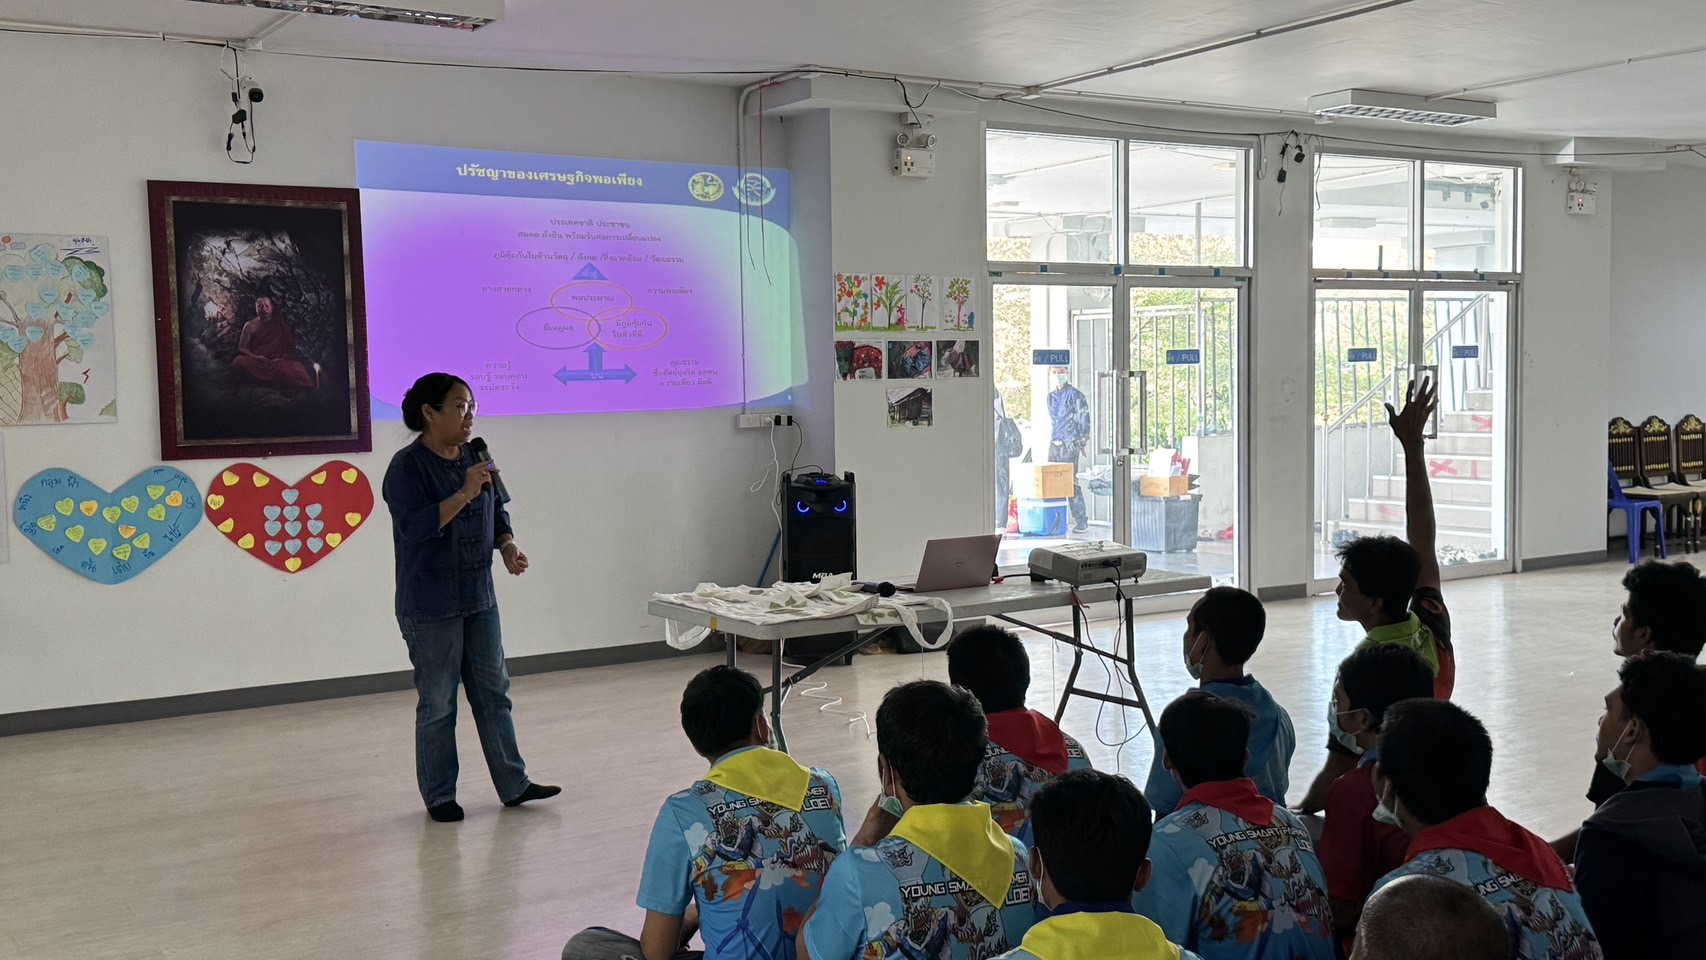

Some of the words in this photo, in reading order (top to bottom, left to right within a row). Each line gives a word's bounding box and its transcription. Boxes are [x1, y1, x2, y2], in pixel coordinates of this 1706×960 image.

[456, 163, 643, 186] ปรัชญาของเศรษฐกิจพอเพียง
[1050, 354, 1069, 363] PULL
[1181, 353, 1198, 362] PULL
[708, 800, 746, 815] YOUNG
[802, 798, 831, 811] LOEI
[1208, 831, 1247, 848] YOUNG
[1247, 827, 1280, 839] SMART
[900, 882, 945, 898] YOUNG
[1005, 886, 1031, 905] LOEI
